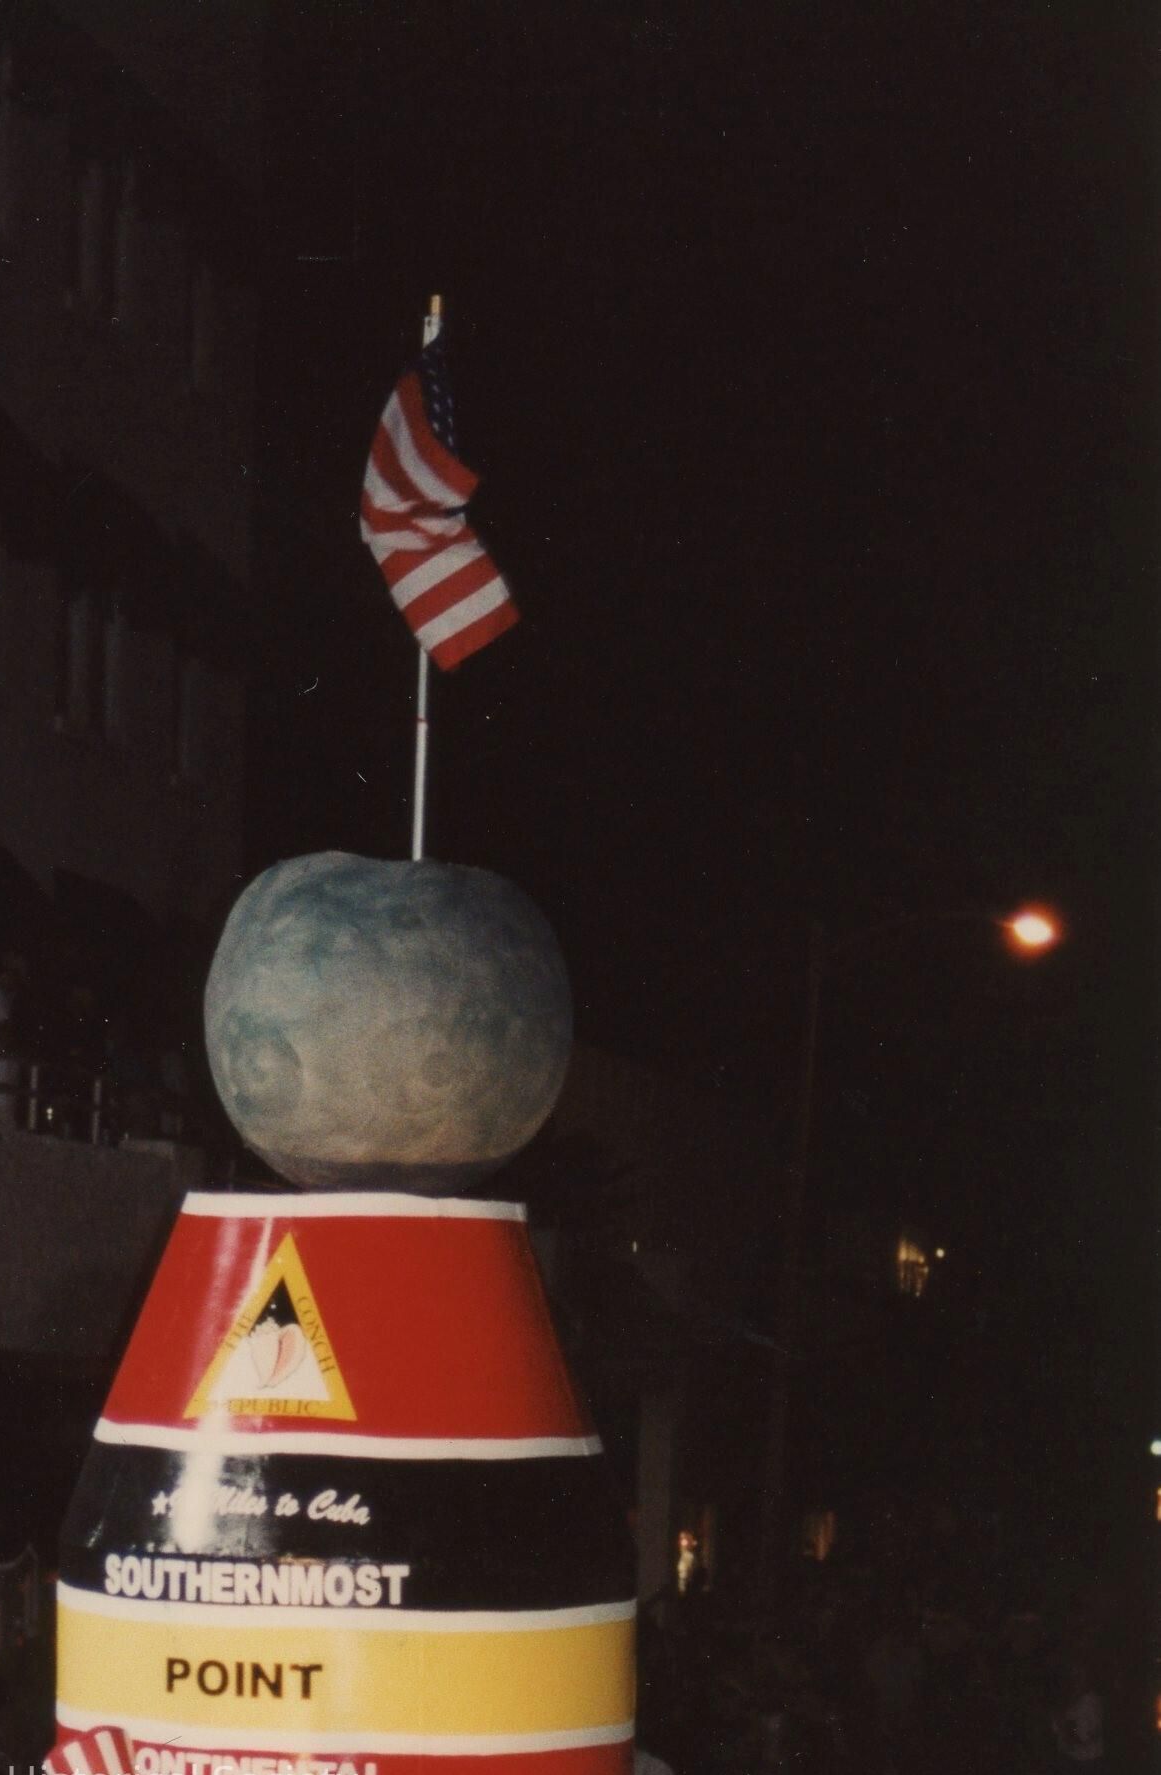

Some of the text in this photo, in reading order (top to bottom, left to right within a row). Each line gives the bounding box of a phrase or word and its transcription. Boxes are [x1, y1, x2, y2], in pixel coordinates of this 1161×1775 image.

[296, 1296, 337, 1374] CONCH
[275, 1493, 299, 1516] to
[307, 1489, 371, 1525] Cuba
[104, 1554, 411, 1606] SOUTHERNMOST
[165, 1656, 323, 1700] POINT
